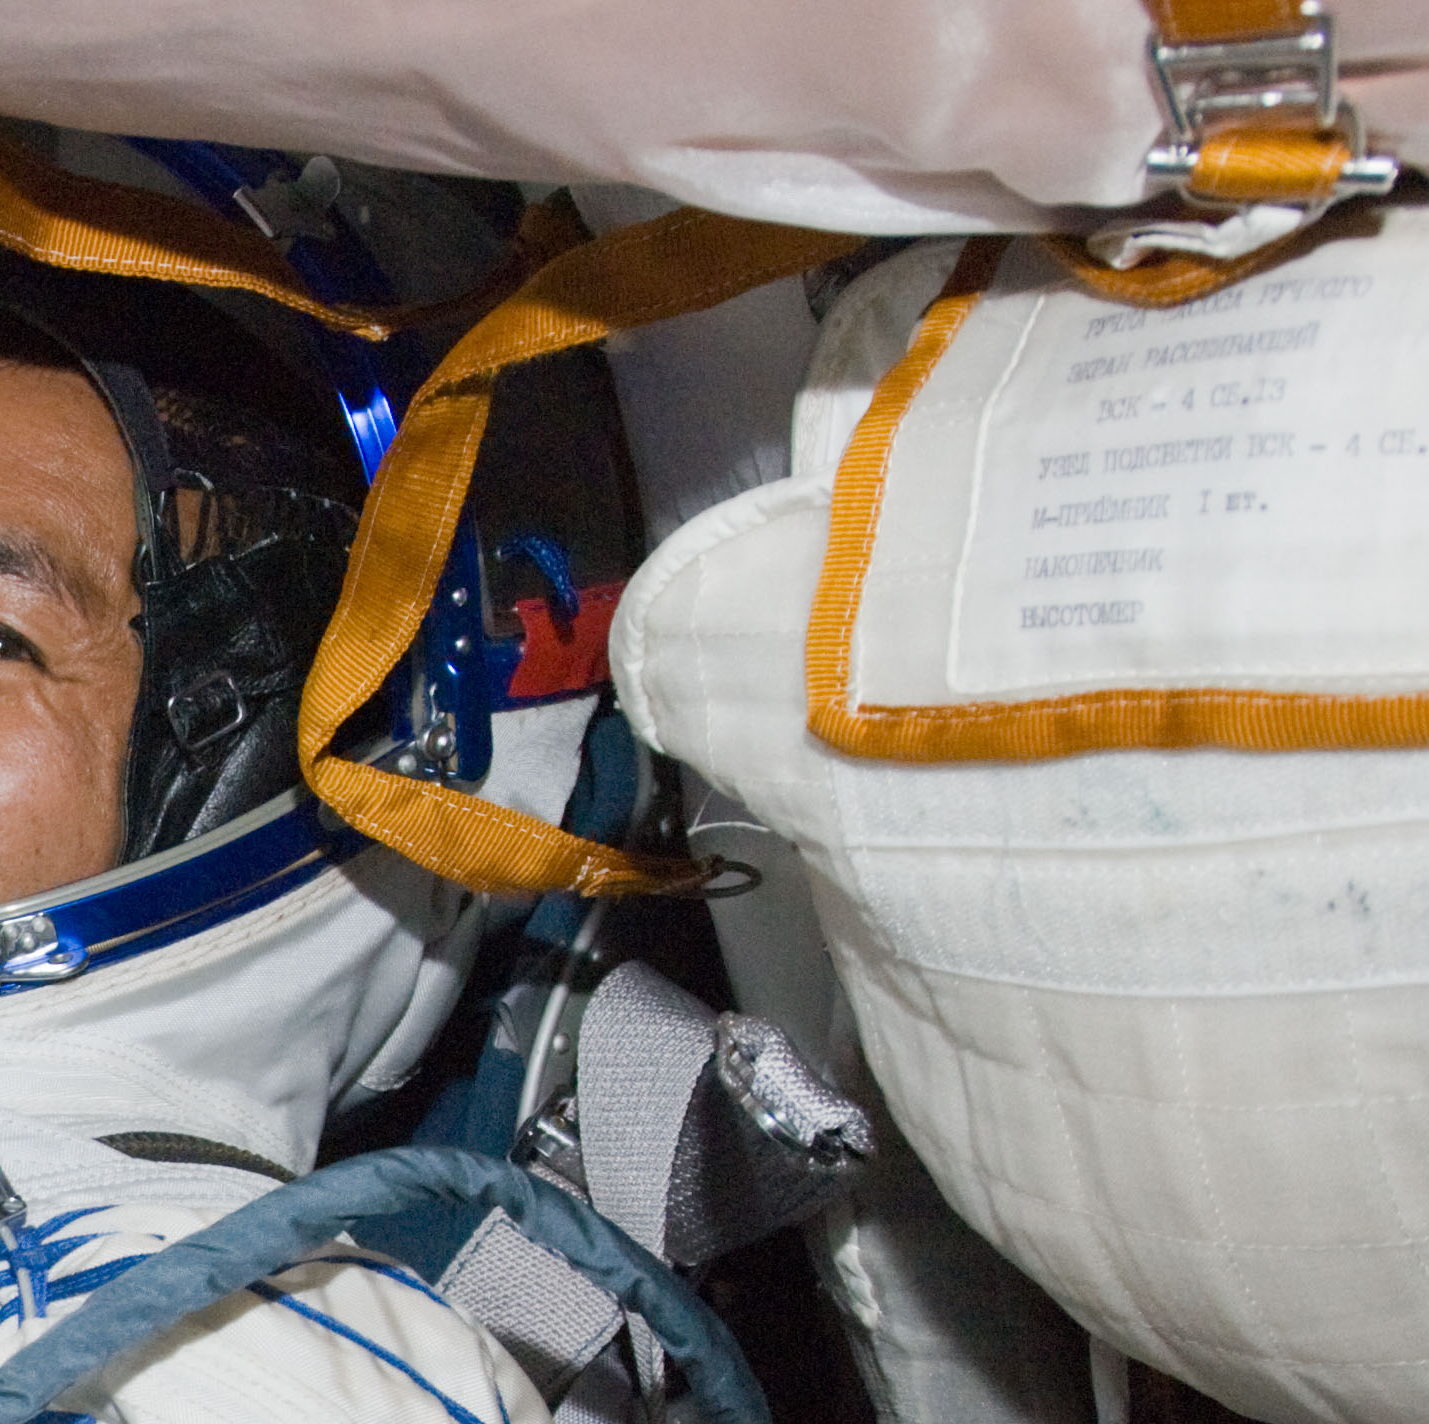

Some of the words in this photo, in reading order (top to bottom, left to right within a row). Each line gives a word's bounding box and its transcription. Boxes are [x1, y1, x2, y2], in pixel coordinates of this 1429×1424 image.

[1038, 451, 1091, 480] УЗЕЛ
[1102, 434, 1233, 475] ПОДСВЕТКИ
[1247, 431, 1295, 458] ВСК
[1345, 432, 1361, 457] 4
[1024, 548, 1164, 579] НАКОНЕЧНИК
[1020, 602, 1143, 630] ВЫСОТОМЕР
